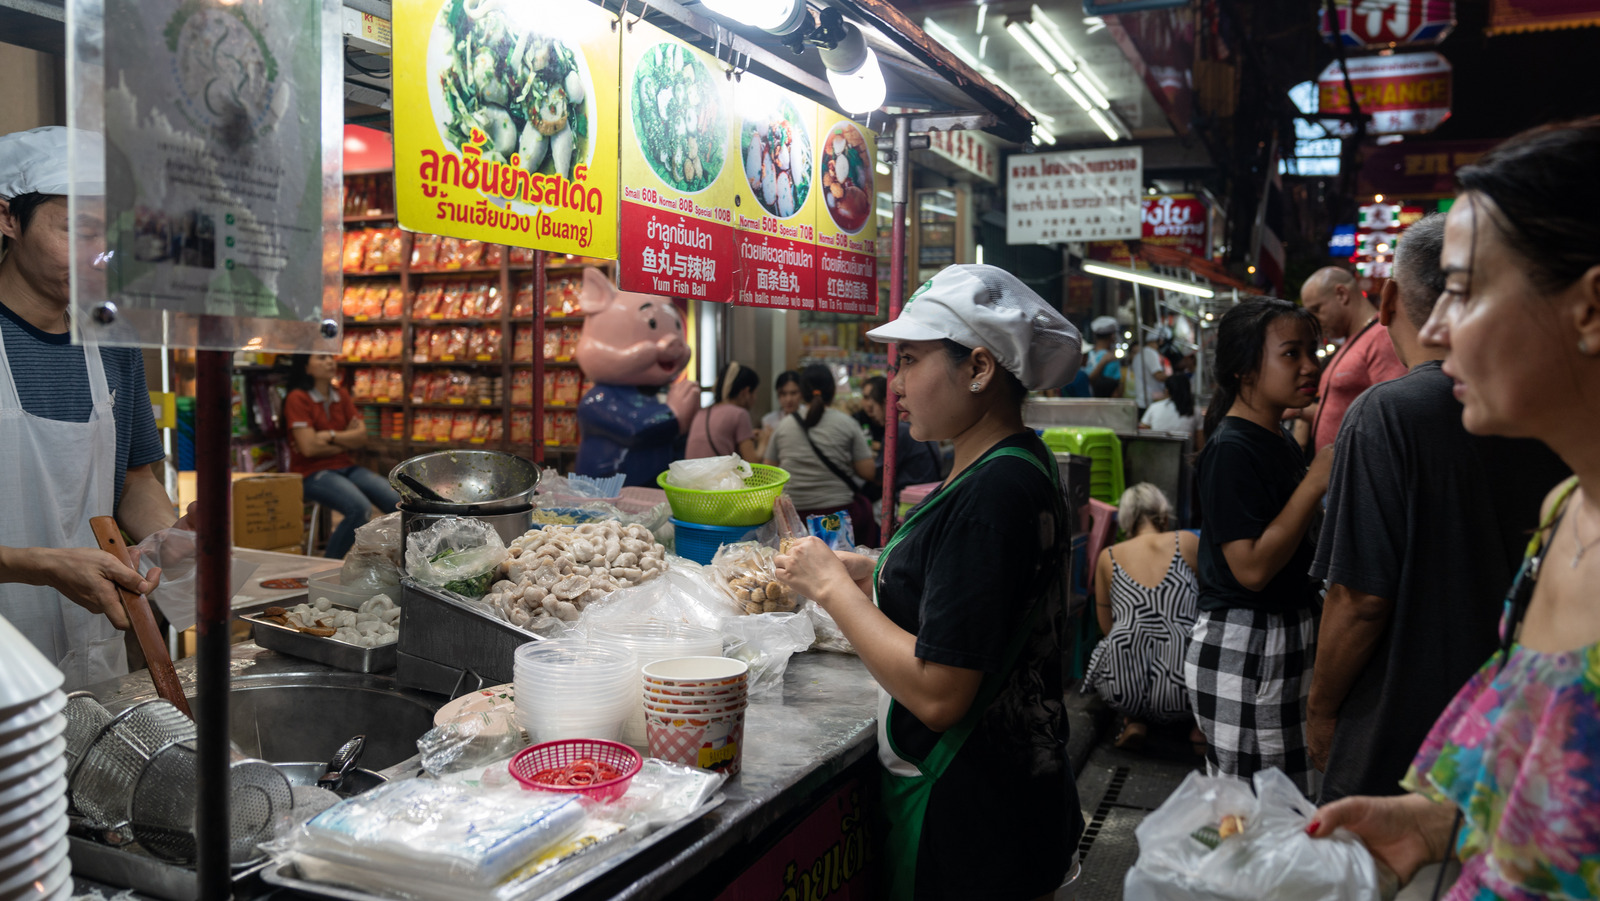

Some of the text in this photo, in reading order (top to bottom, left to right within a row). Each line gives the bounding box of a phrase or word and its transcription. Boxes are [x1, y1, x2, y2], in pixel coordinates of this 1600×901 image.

[419, 128, 603, 215] ลูกชิ้นยำรสเด็ด
[624, 186, 731, 222] Small 60B Normal 80B Special 100B
[436, 191, 593, 248] ร้านเฮียบ่วง (Buang)
[740, 215, 814, 241] Normal 50B Special 70B
[647, 215, 713, 251] ยำลูกชิ้นปลา
[819, 233, 835, 246] Normal
[837, 233, 848, 248] 50B
[641, 245, 716, 283] 鱼丸与辣椒
[652, 276, 707, 297] Yum Fish Ball
[757, 268, 801, 293] 面条鱼丸
[828, 278, 869, 300] 红色的面条
[740, 290, 753, 303] Fish
[755, 292, 769, 304] balls
[771, 295, 789, 306] noodle
[803, 299, 815, 310] soup
[819, 298, 828, 309] Yen
[830, 299, 836, 310] Ta
